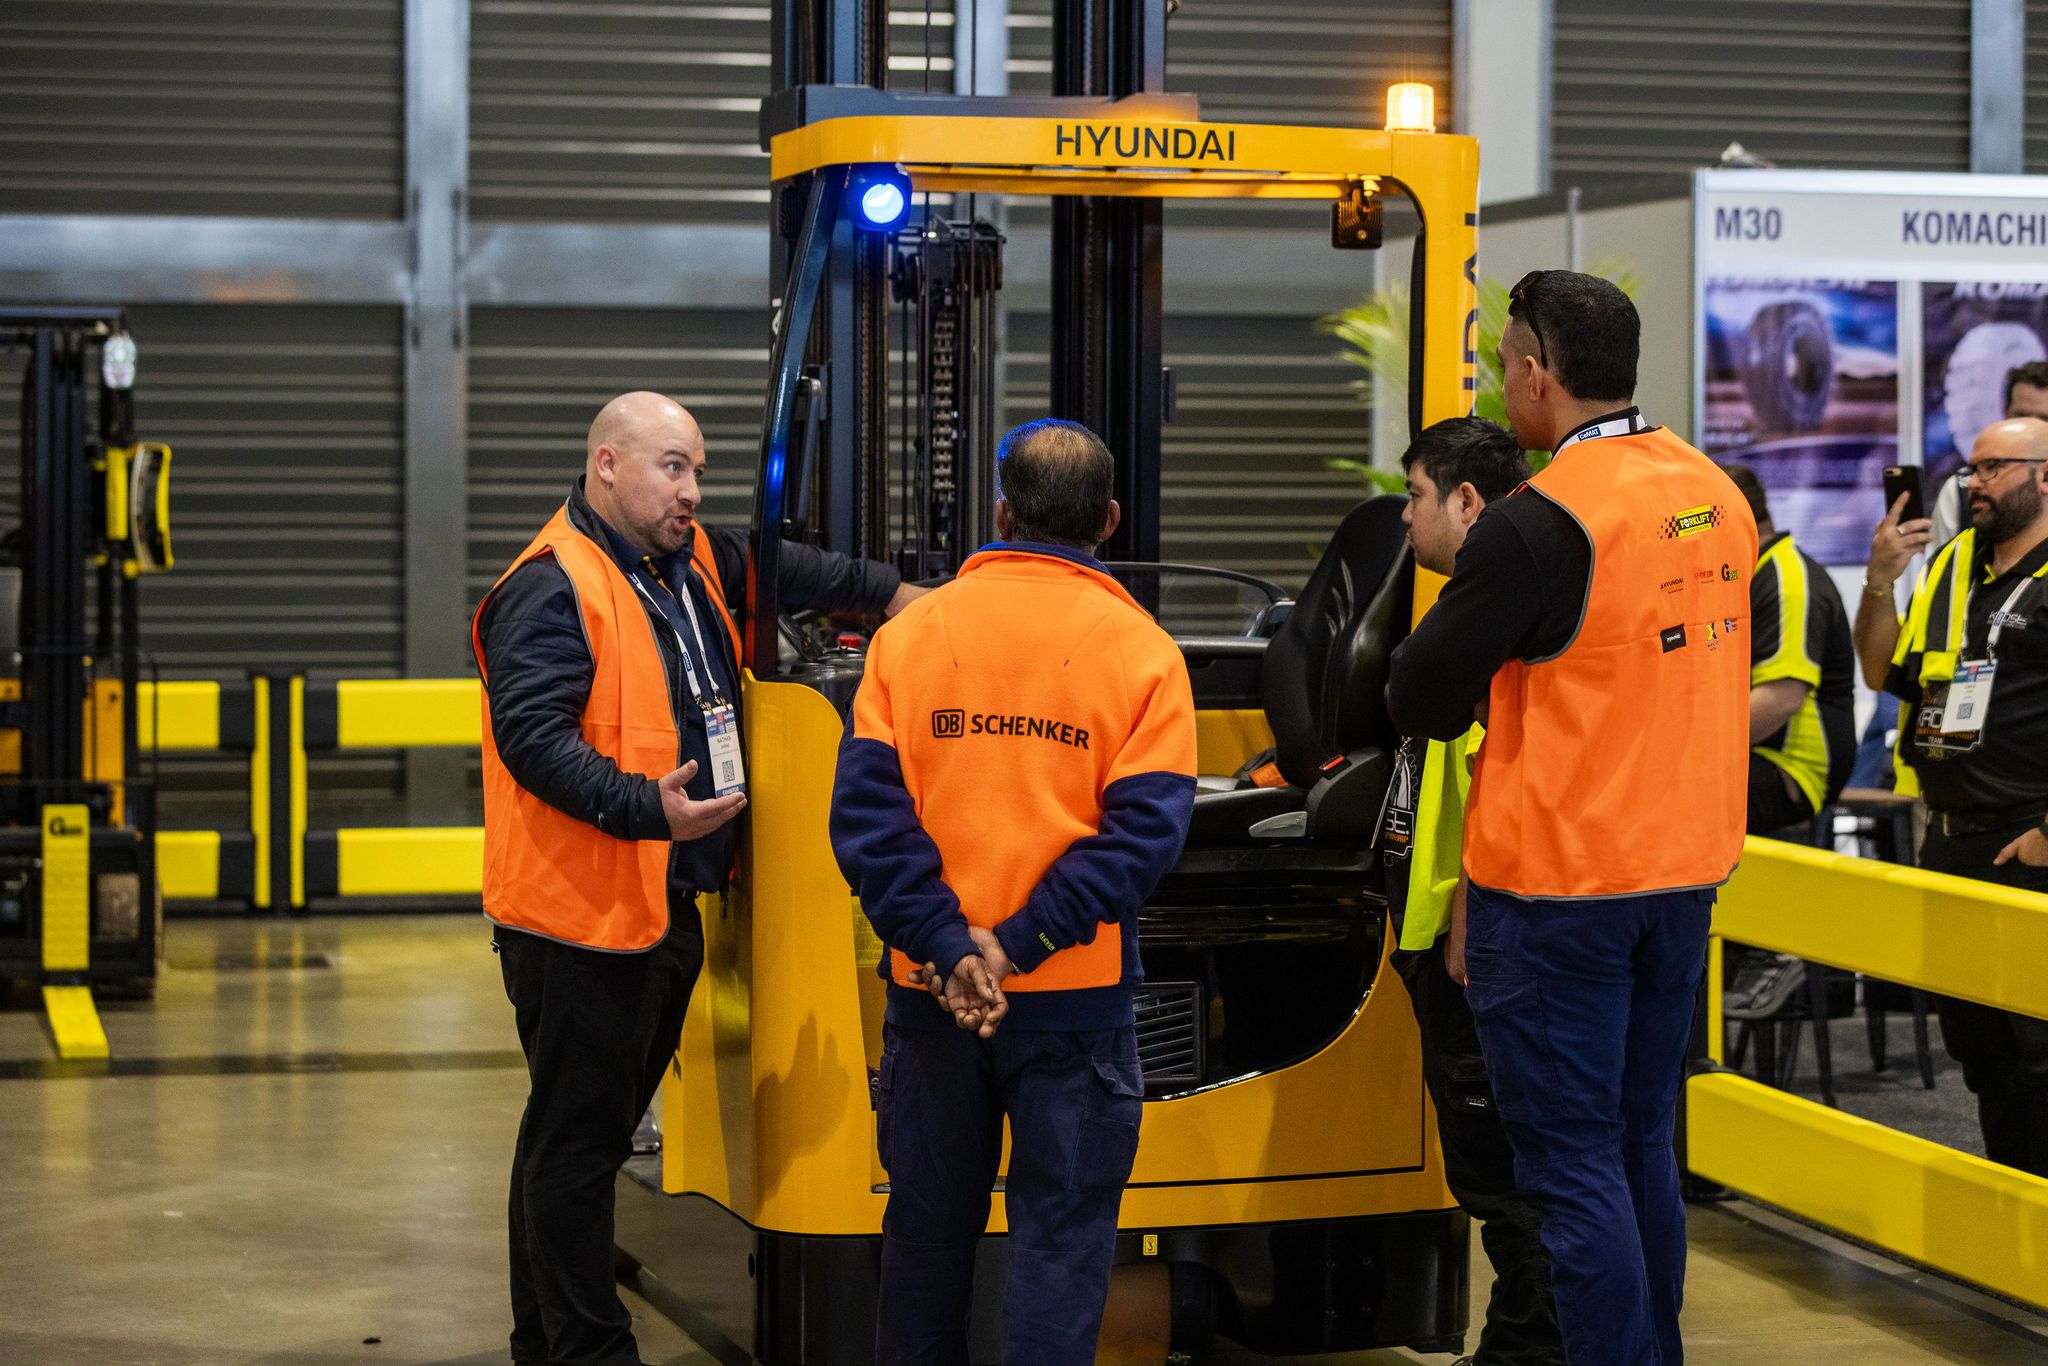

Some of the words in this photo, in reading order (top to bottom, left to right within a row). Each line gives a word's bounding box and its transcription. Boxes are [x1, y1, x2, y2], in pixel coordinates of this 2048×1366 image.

[1056, 124, 1235, 161] HYUNDAI
[1715, 206, 1782, 241] M30
[1902, 211, 2048, 247] KOMACHI
[1579, 427, 1599, 440] CeMAT
[935, 712, 961, 735] DB
[970, 713, 1090, 750] SCHENKER
